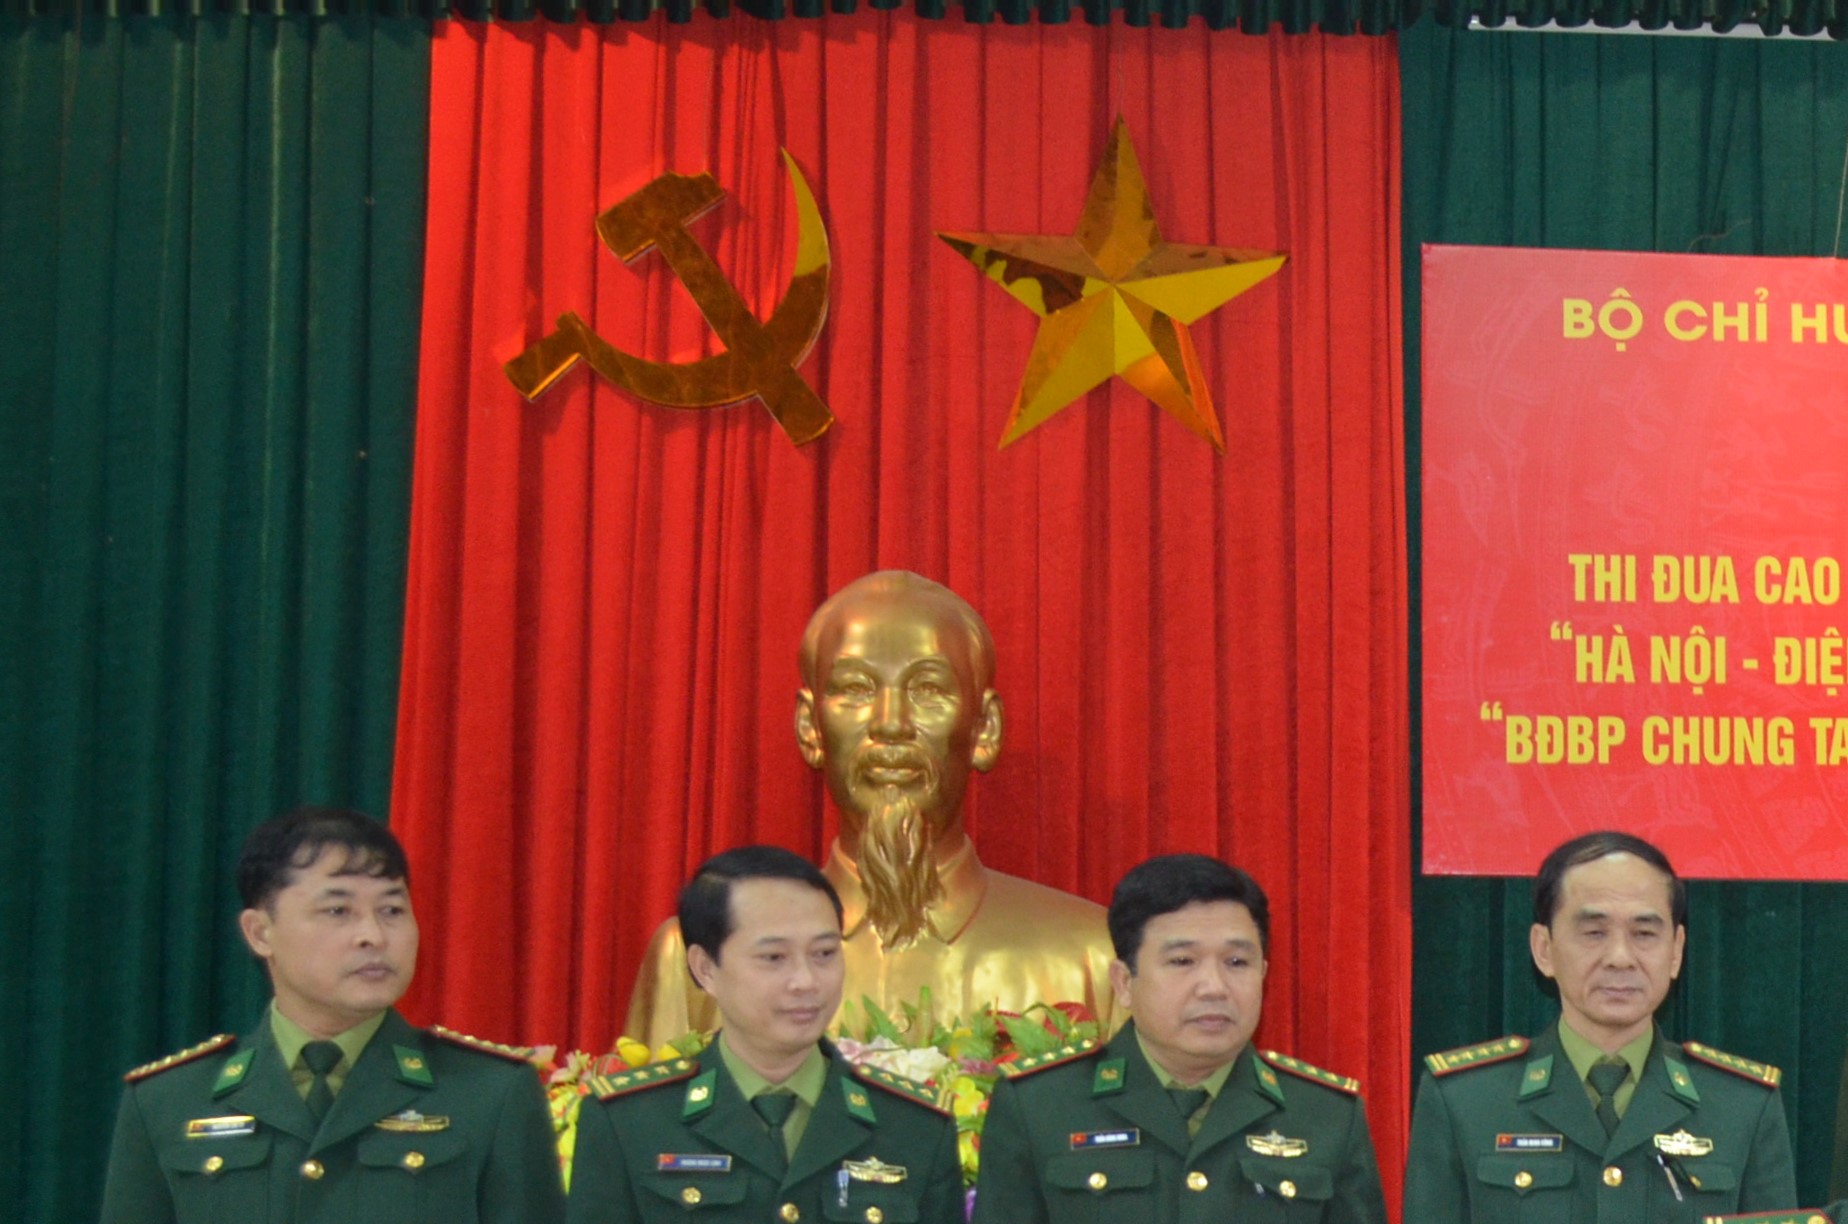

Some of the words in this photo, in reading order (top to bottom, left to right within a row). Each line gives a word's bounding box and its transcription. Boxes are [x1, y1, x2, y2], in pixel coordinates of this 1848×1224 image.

[1562, 287, 1644, 352] BỘ
[1663, 287, 1769, 343] CHỈ
[1567, 553, 1637, 603] THI
[1651, 554, 1740, 604] ĐUA
[1754, 555, 1841, 605] CAO
[1650, 625, 1727, 695] NỘI
[1742, 658, 1759, 670] -
[1642, 715, 1796, 767] CHUNG
